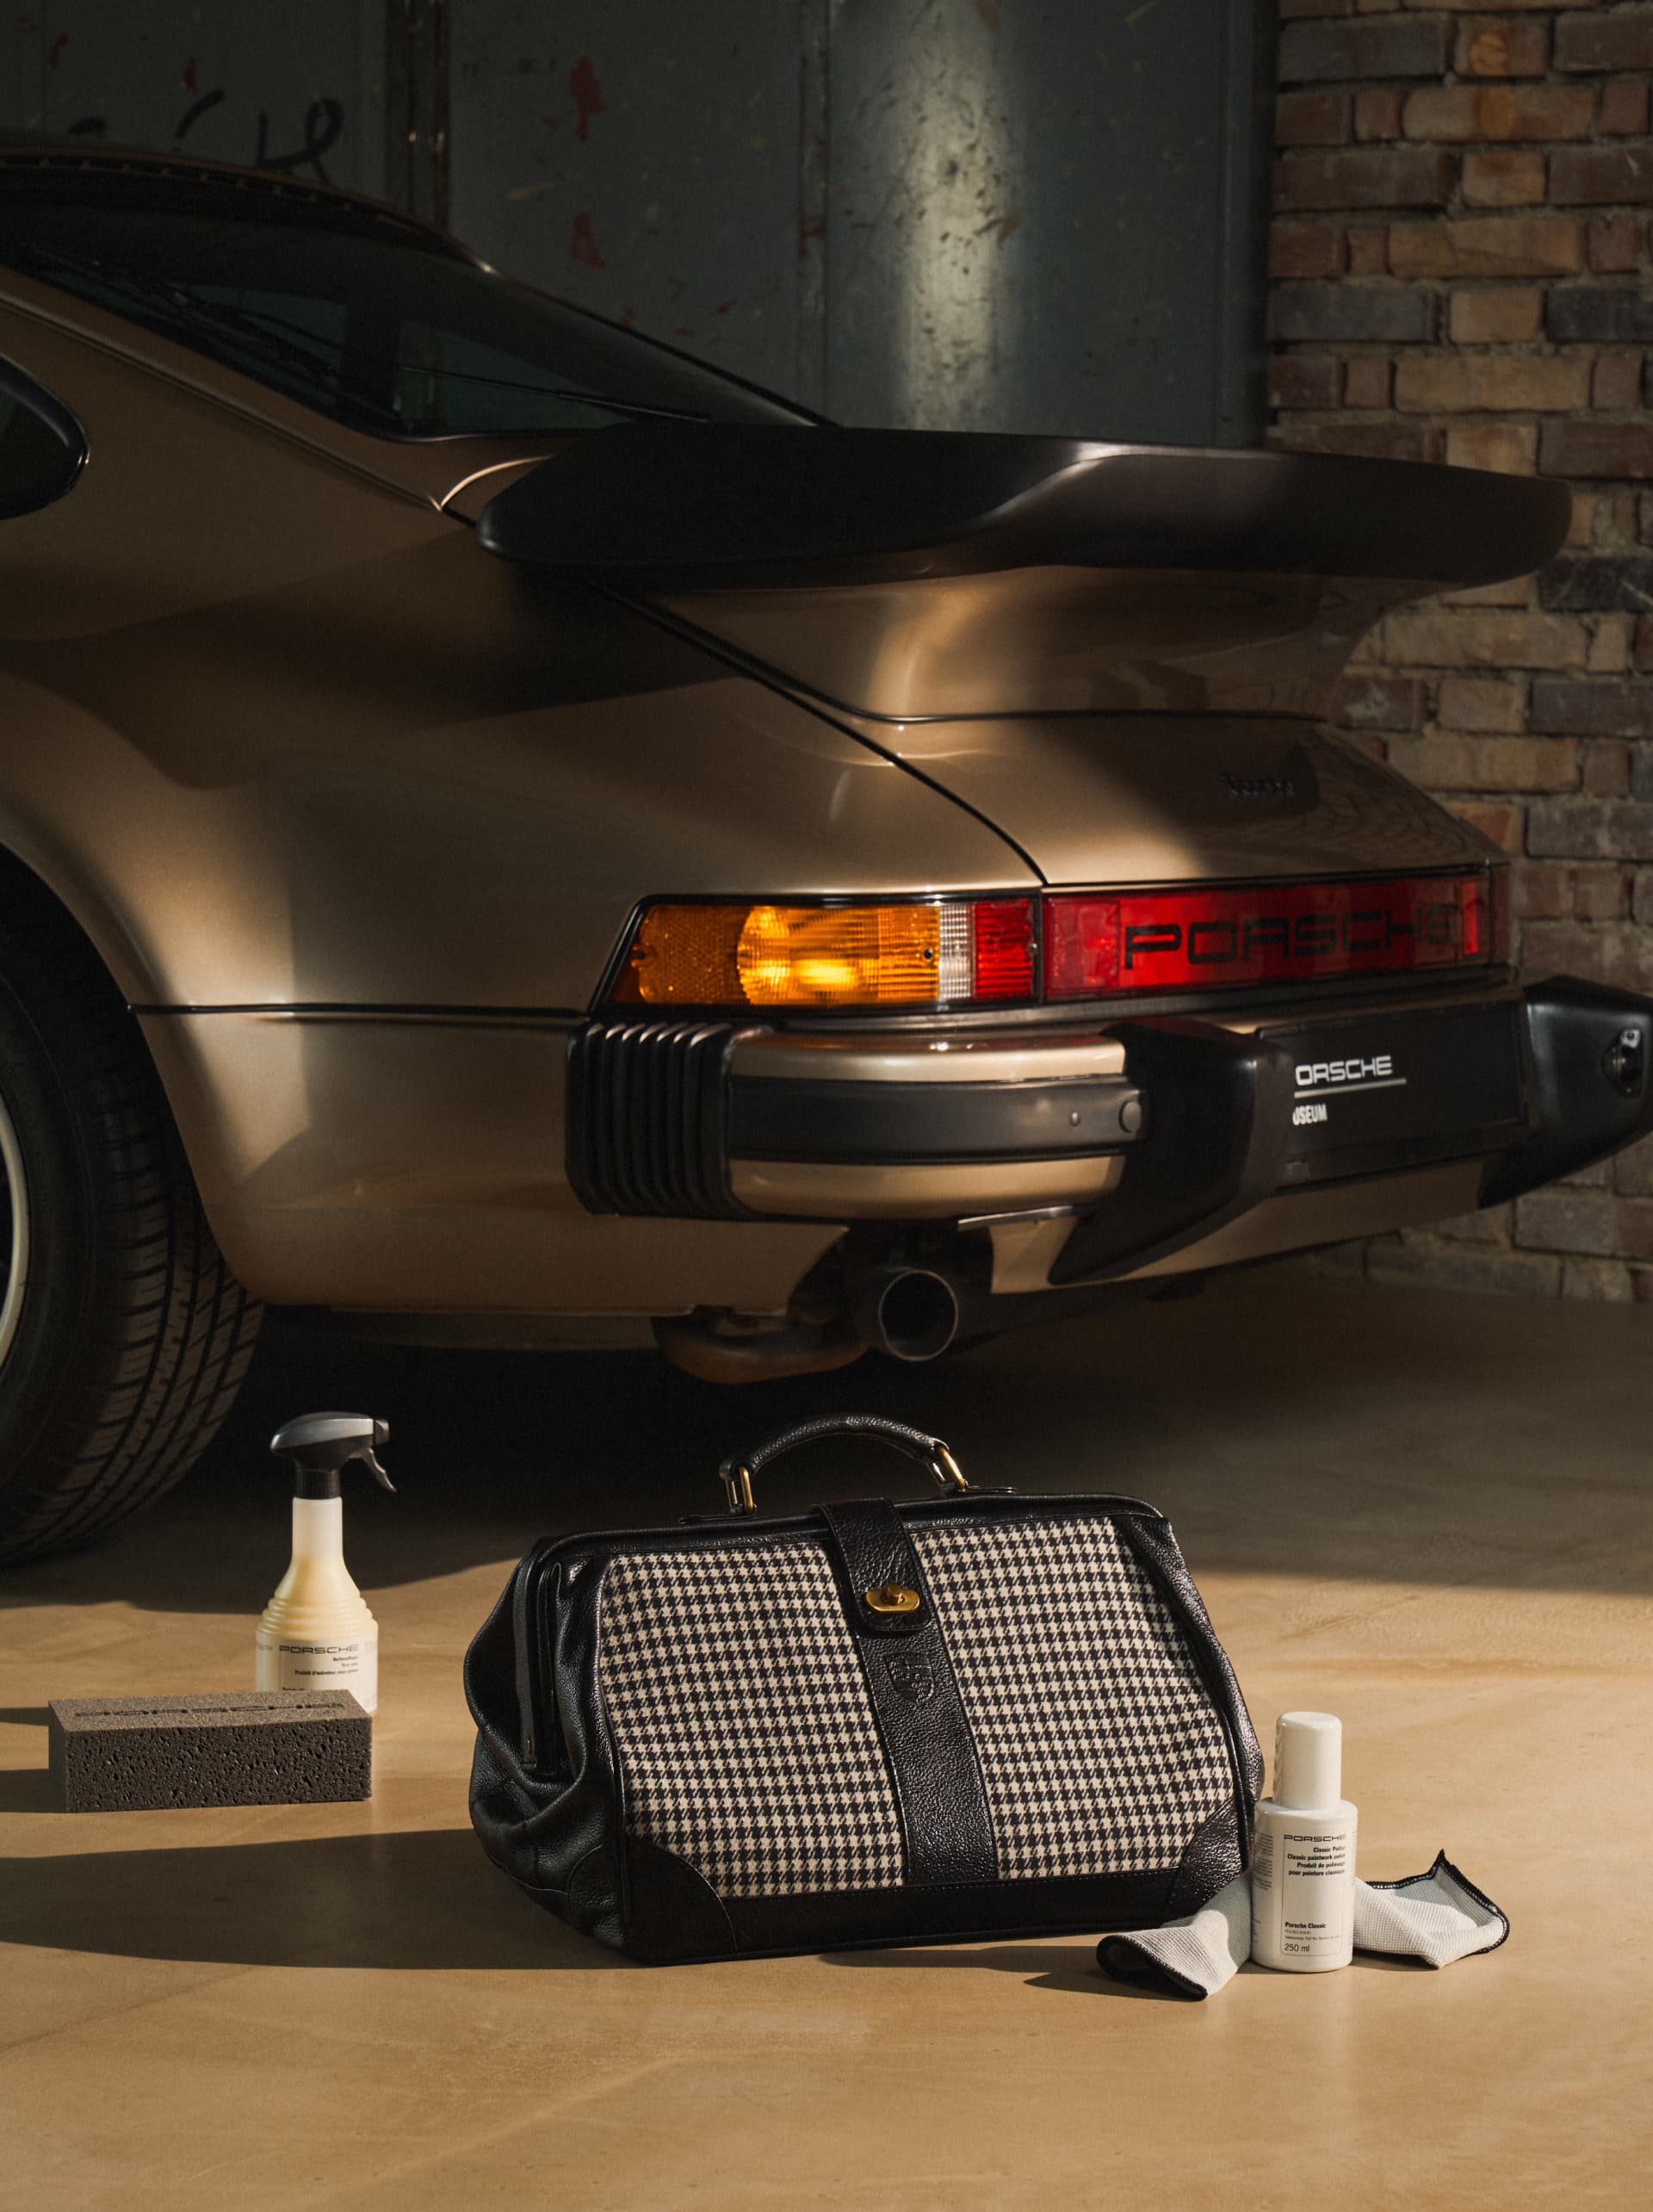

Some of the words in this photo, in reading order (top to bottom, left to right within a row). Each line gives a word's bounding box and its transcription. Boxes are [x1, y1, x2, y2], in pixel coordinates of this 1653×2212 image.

[1124, 905, 1458, 970] PORSCHE
[1295, 1054, 1393, 1086] ORSCHE
[1292, 1102, 1328, 1126] USEUM
[279, 1645, 358, 1654] PORSCHE
[1284, 1834, 1347, 1843] PORSCHE
[1284, 1942, 1299, 1952] 250
